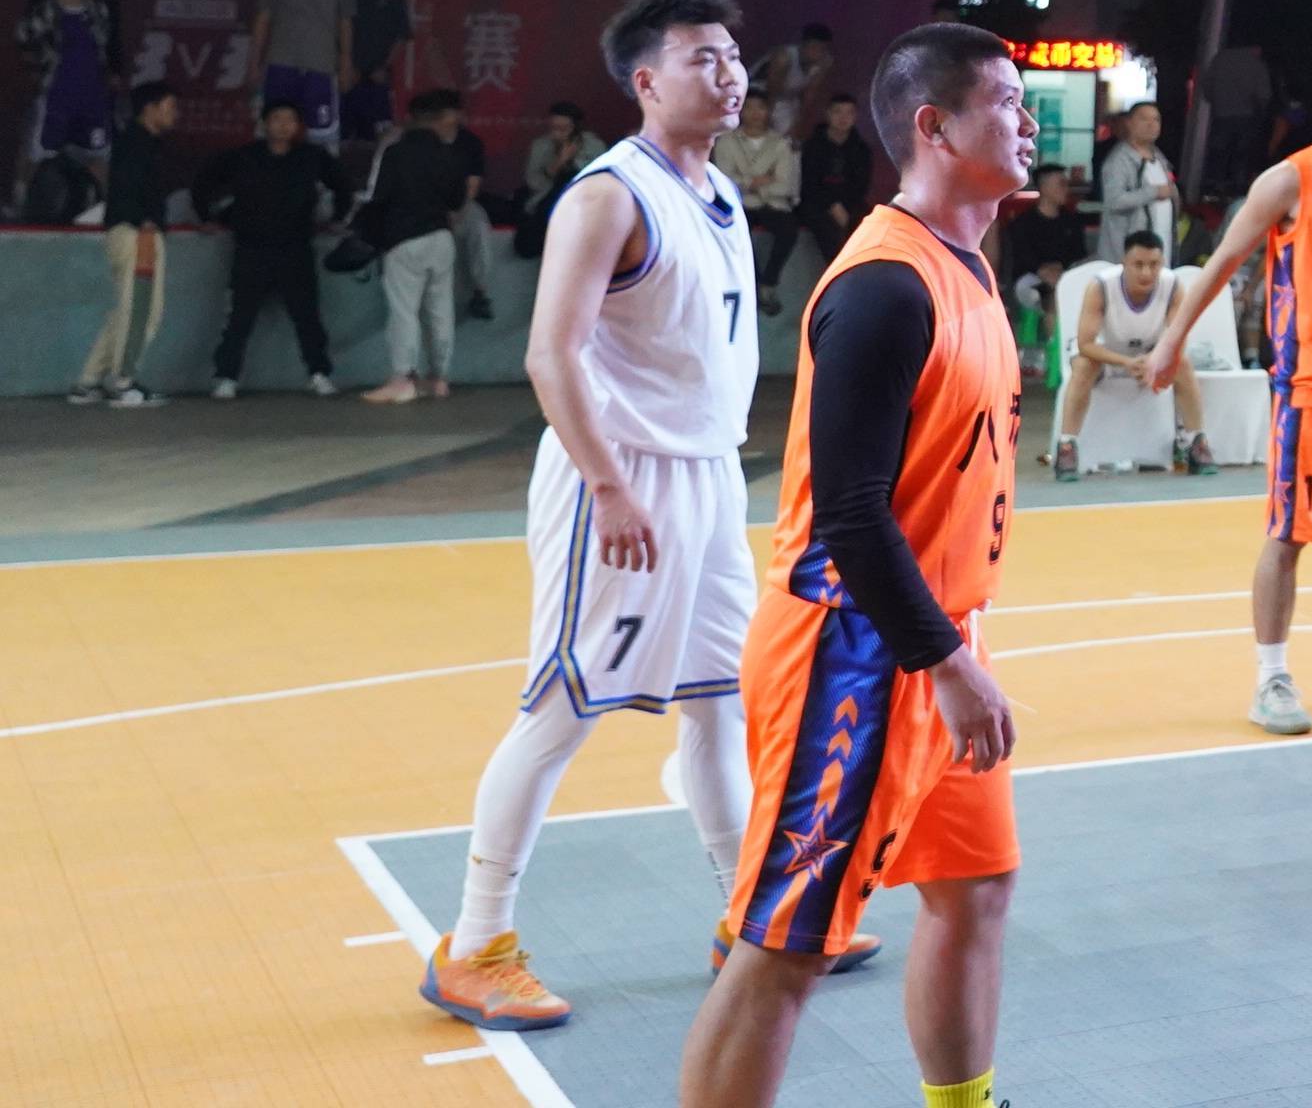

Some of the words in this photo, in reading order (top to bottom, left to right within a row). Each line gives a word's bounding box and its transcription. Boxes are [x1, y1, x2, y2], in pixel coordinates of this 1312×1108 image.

[722, 290, 743, 346] 7
[988, 491, 1007, 564] 9
[608, 614, 645, 672] 7
